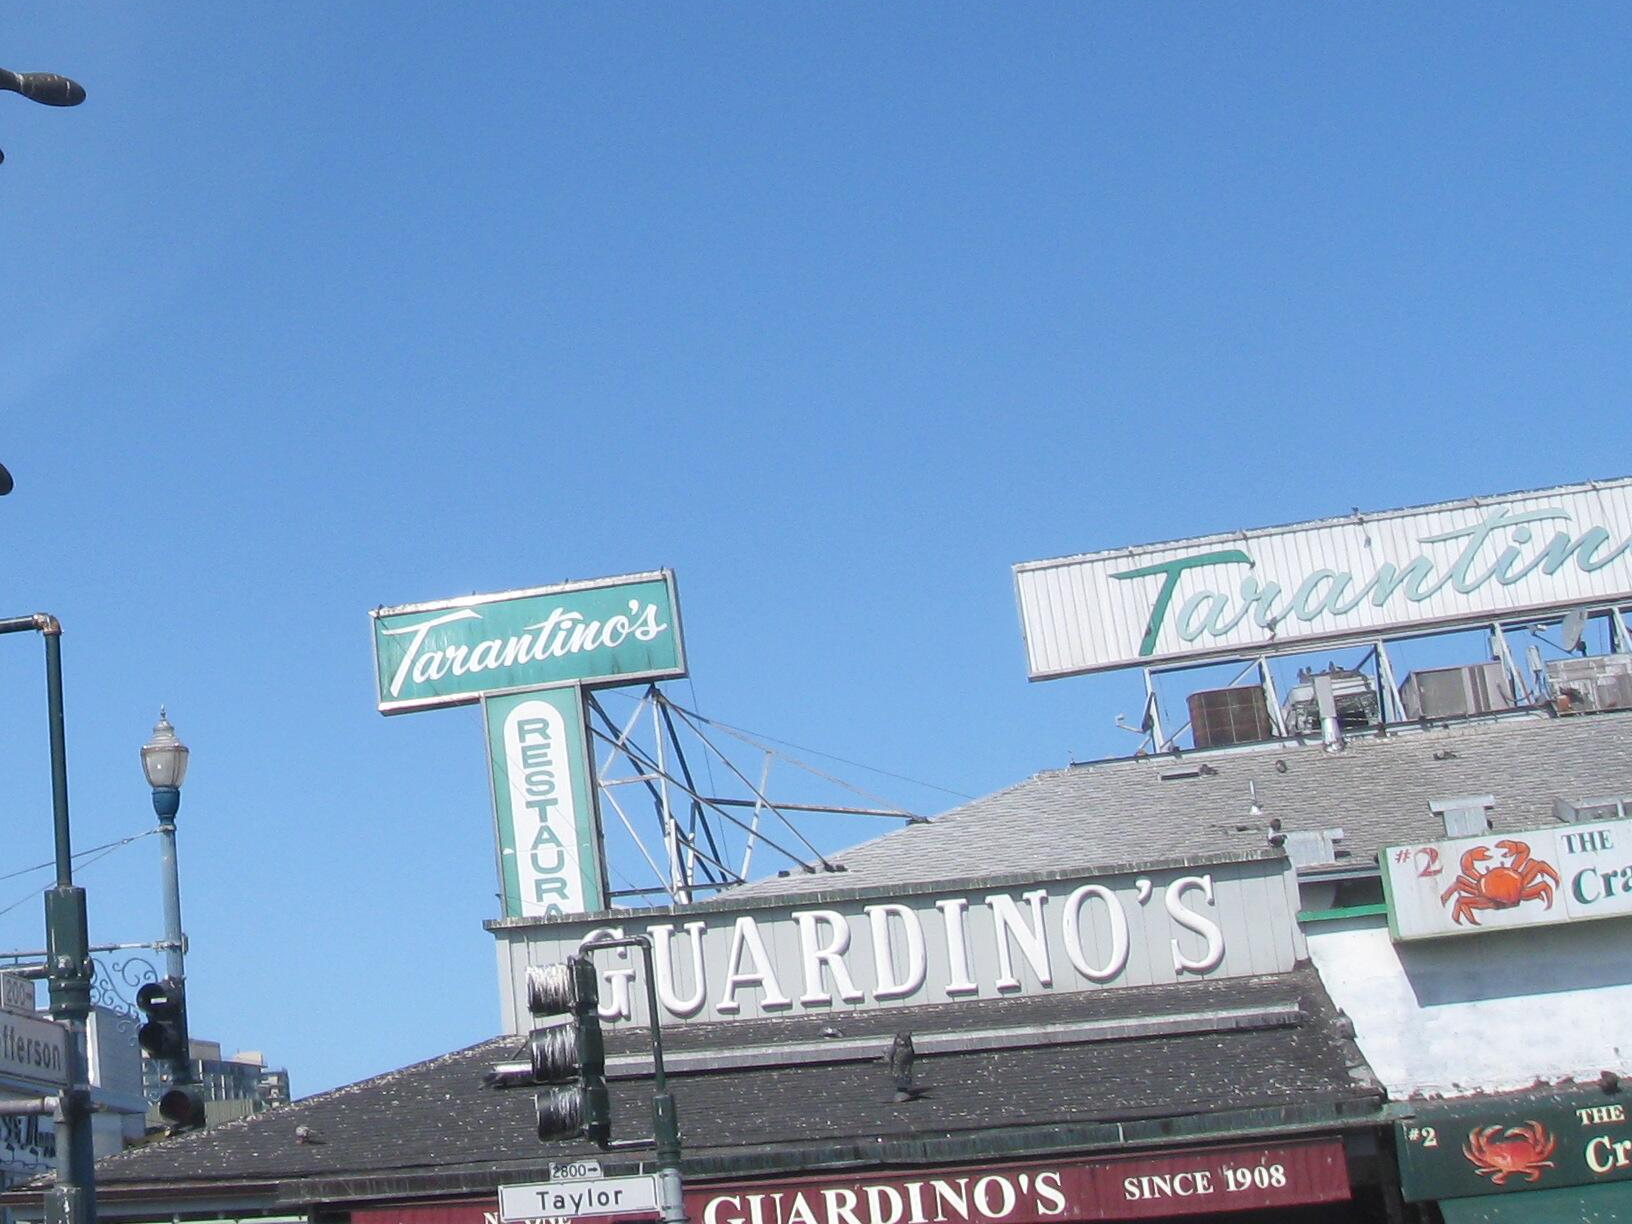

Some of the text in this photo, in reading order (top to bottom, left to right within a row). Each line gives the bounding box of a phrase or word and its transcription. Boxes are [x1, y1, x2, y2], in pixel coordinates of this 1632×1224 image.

[381, 598, 668, 698] Tarantino's
[1561, 829, 1614, 855] THE
[1394, 847, 1444, 878] #2
[579, 874, 1226, 1022] GUARDINO'S
[1576, 1104, 1626, 1126] THE
[1407, 1126, 1439, 1148] #2
[552, 1164, 587, 1179] 2800
[536, 1188, 624, 1215] Taylor
[702, 1163, 1287, 1224] GUARDINO'S SINCE 1908
